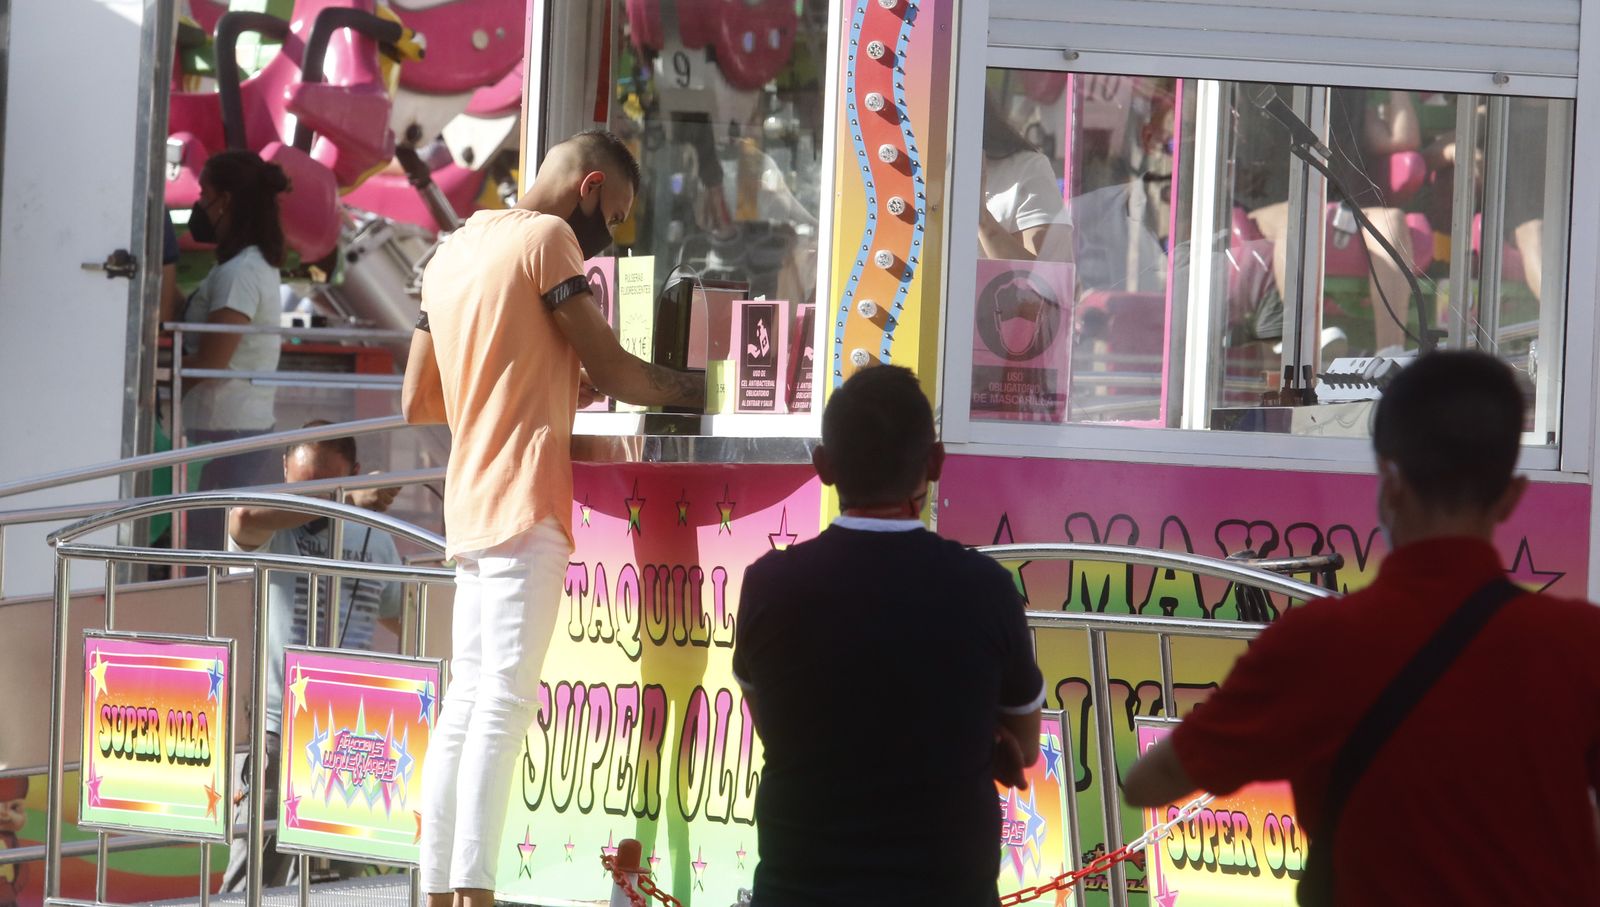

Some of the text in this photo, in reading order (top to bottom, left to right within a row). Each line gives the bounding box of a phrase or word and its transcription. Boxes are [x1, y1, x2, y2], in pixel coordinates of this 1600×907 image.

[673, 51, 691, 88] 9
[973, 393, 1054, 407] DE MASCARILLA
[988, 382, 1040, 394] OBLIGATORIO
[1007, 371, 1023, 381] USO
[565, 562, 735, 662] TAQUILL
[98, 704, 212, 767] SUPER OLLA
[523, 680, 759, 826] SUPER OLL
[1166, 805, 1261, 877] SUPER
